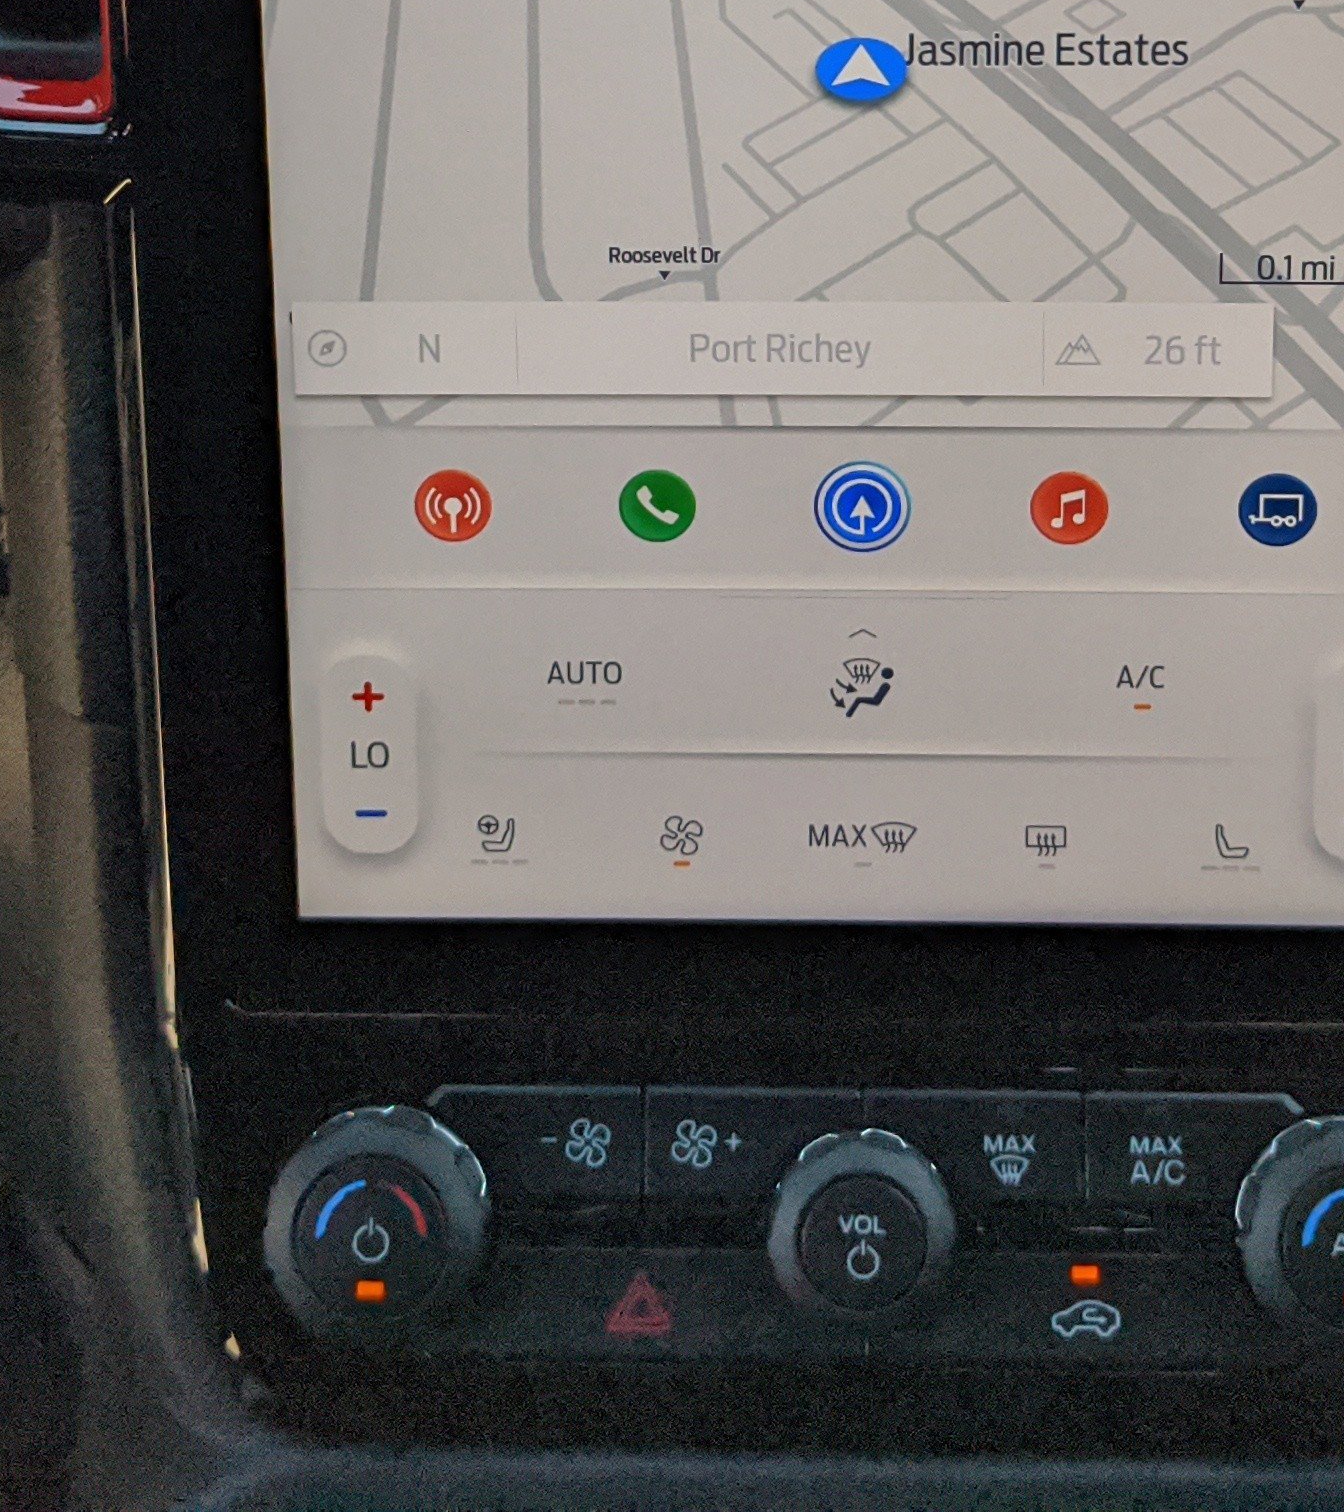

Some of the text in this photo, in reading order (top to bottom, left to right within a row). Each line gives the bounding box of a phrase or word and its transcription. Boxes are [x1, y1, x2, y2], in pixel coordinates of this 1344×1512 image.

[905, 33, 1189, 68] Jasmine Estates
[608, 246, 720, 265] Roosevelt Dr
[1258, 255, 1335, 280] 0.1 mi
[418, 335, 441, 363] N
[689, 333, 871, 369] Port Richey
[1144, 334, 1221, 365] 26 ft
[547, 661, 622, 685] AUTO
[1116, 665, 1164, 690] A/C
[350, 741, 389, 769] LO
[808, 824, 867, 847] MAX
[983, 1134, 1036, 1154] MAX
[1129, 1135, 1183, 1155] MAX
[1130, 1159, 1186, 1187] A/C
[838, 1215, 885, 1235] VOL
